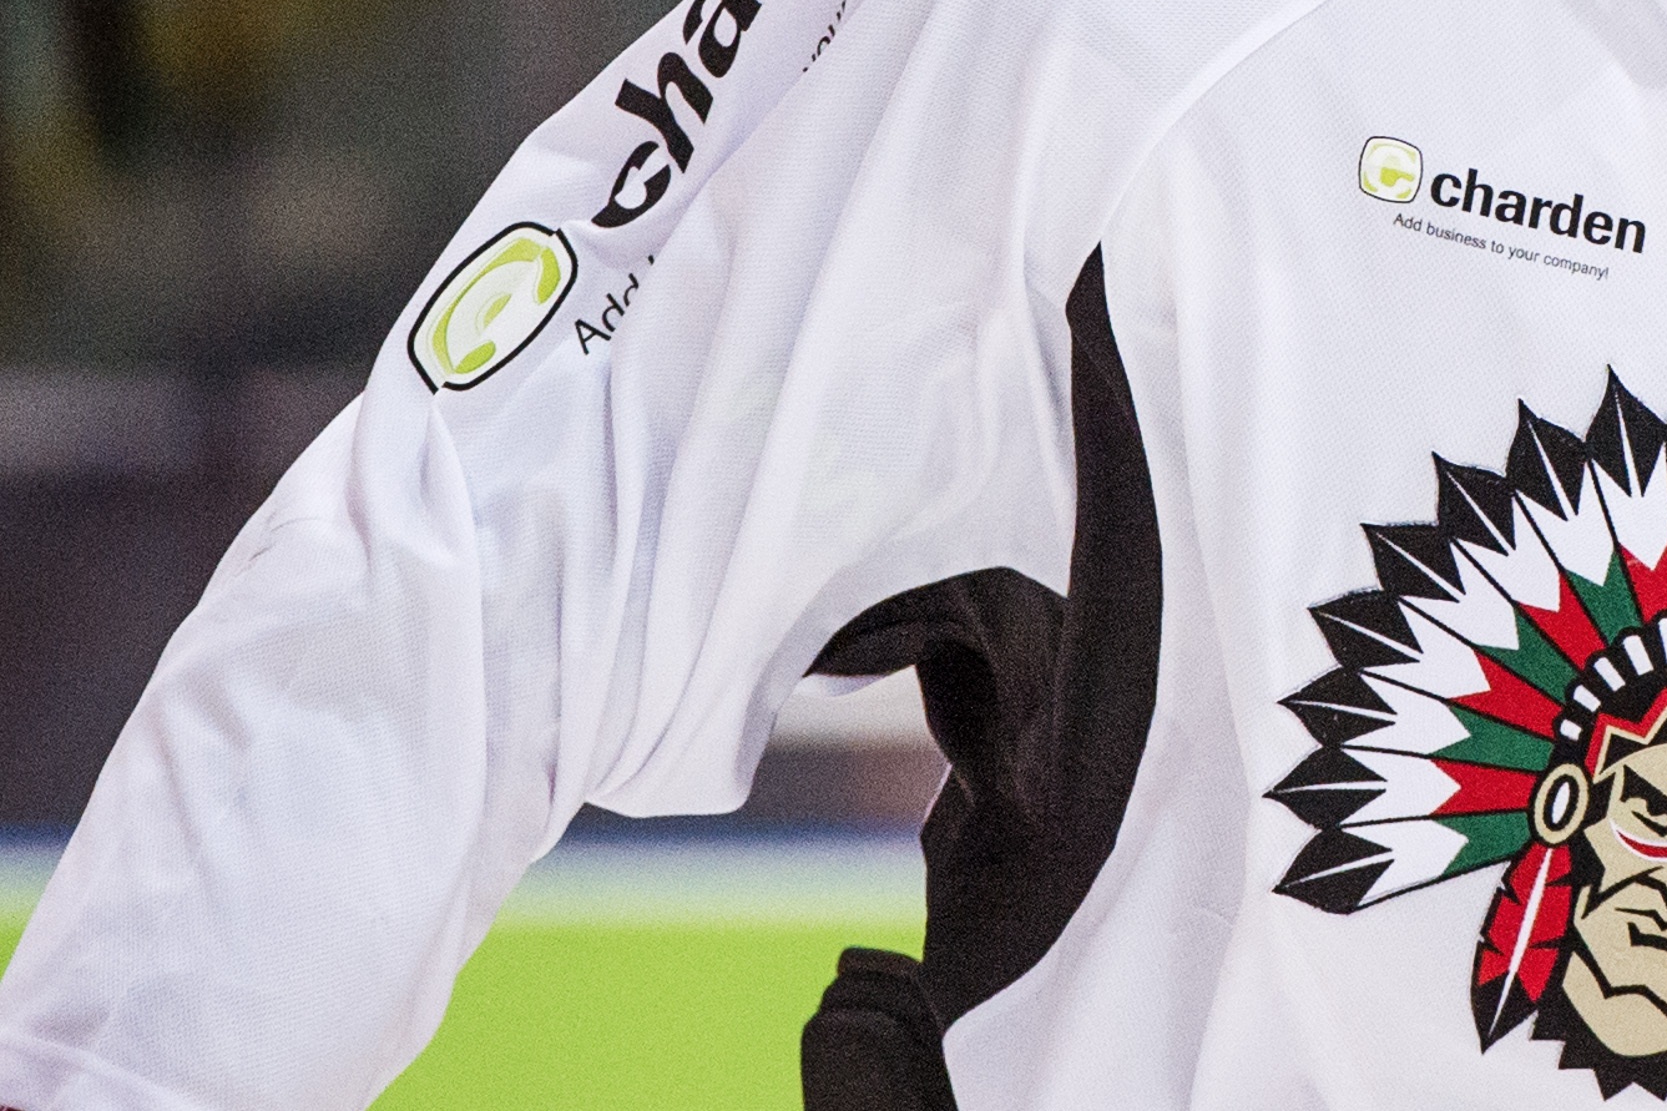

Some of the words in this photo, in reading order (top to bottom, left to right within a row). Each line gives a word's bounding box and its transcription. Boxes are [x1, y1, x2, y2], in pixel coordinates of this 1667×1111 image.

[1393, 213, 1422, 233] Add
[1427, 221, 1486, 250] business
[1491, 240, 1504, 254] to
[1508, 246, 1540, 264] your
[1543, 253, 1610, 280] company!
[1430, 168, 1646, 254] charden
